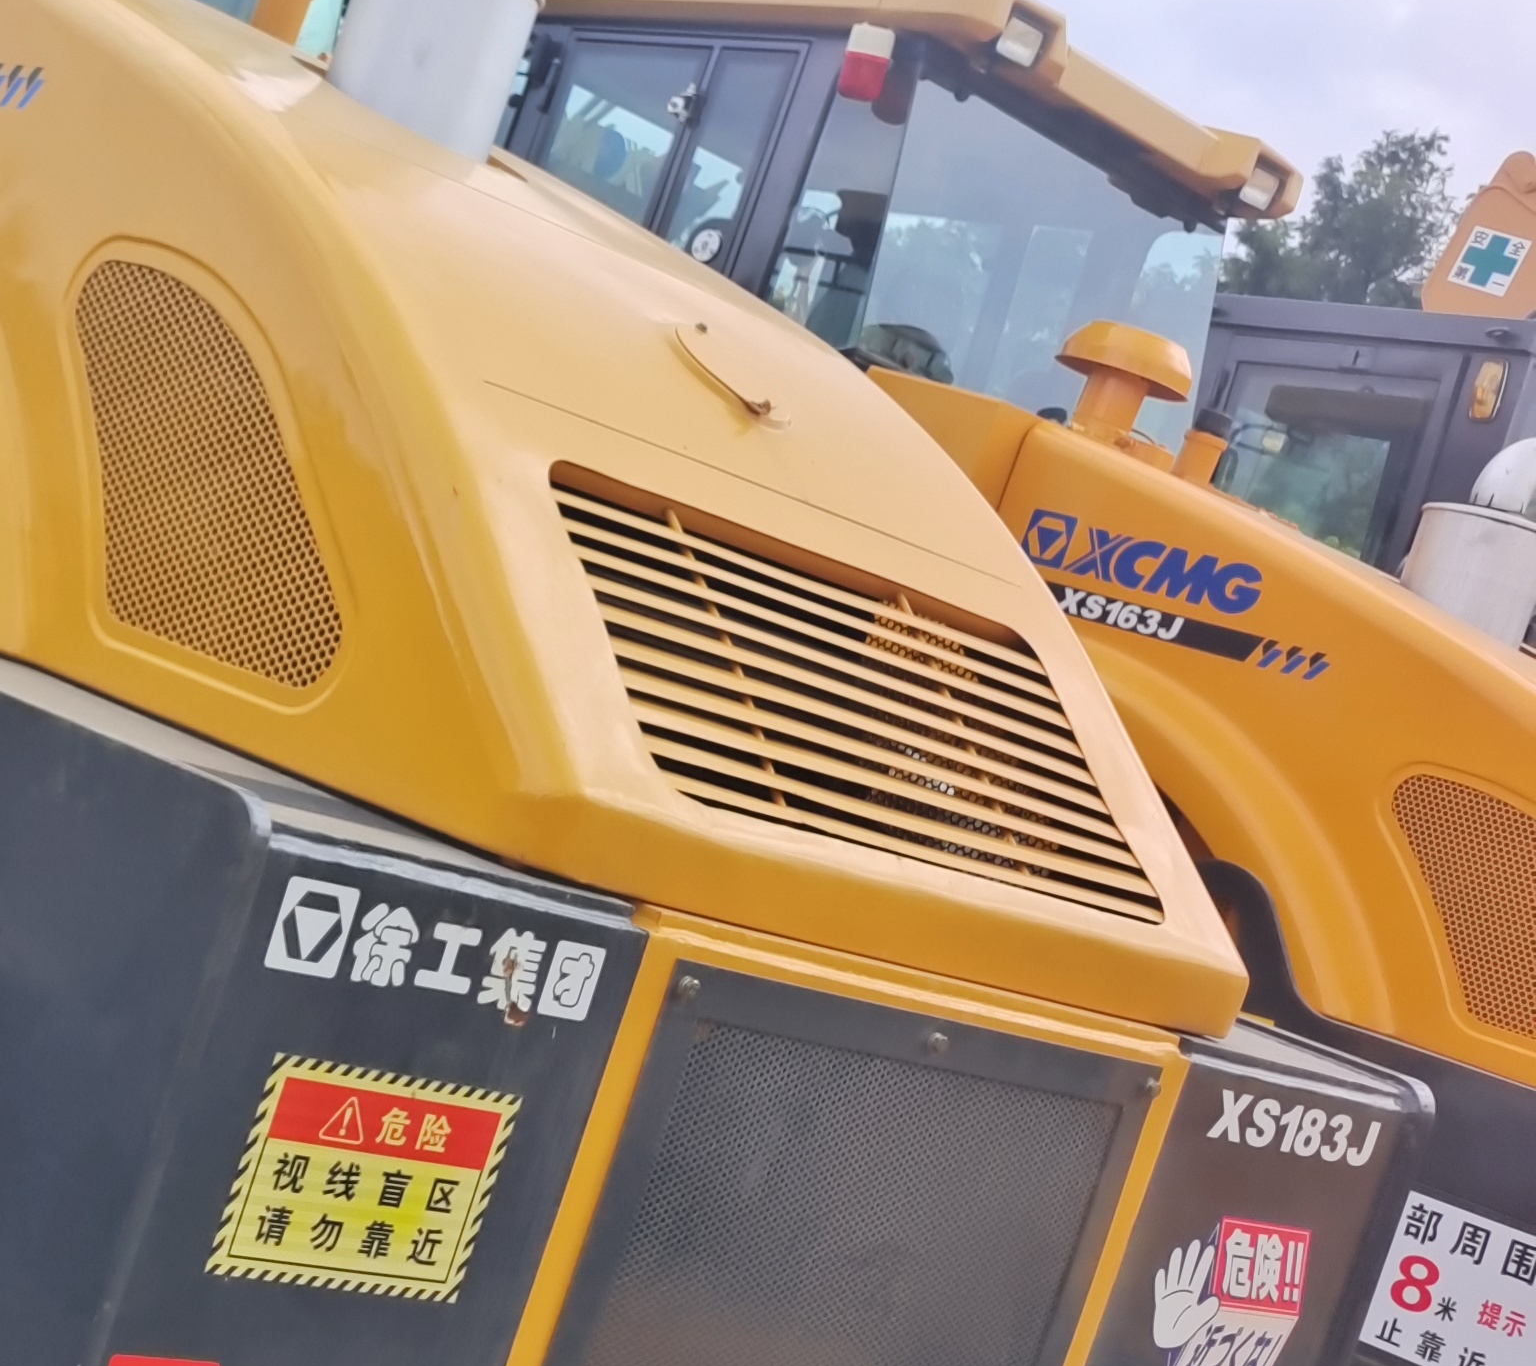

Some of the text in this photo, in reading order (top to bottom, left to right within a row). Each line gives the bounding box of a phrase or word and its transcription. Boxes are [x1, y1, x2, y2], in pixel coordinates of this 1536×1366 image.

[1065, 525, 1262, 615] XCMG
[1058, 586, 1185, 643] XS163J
[351, 902, 606, 1022] 徐工集团
[376, 1107, 453, 1153] 危险
[1207, 1089, 1382, 1167] XS183J
[272, 1152, 461, 1214] 视线盲区
[254, 1207, 445, 1267] 请勿靠近
[1476, 1299, 1527, 1338] 提示
